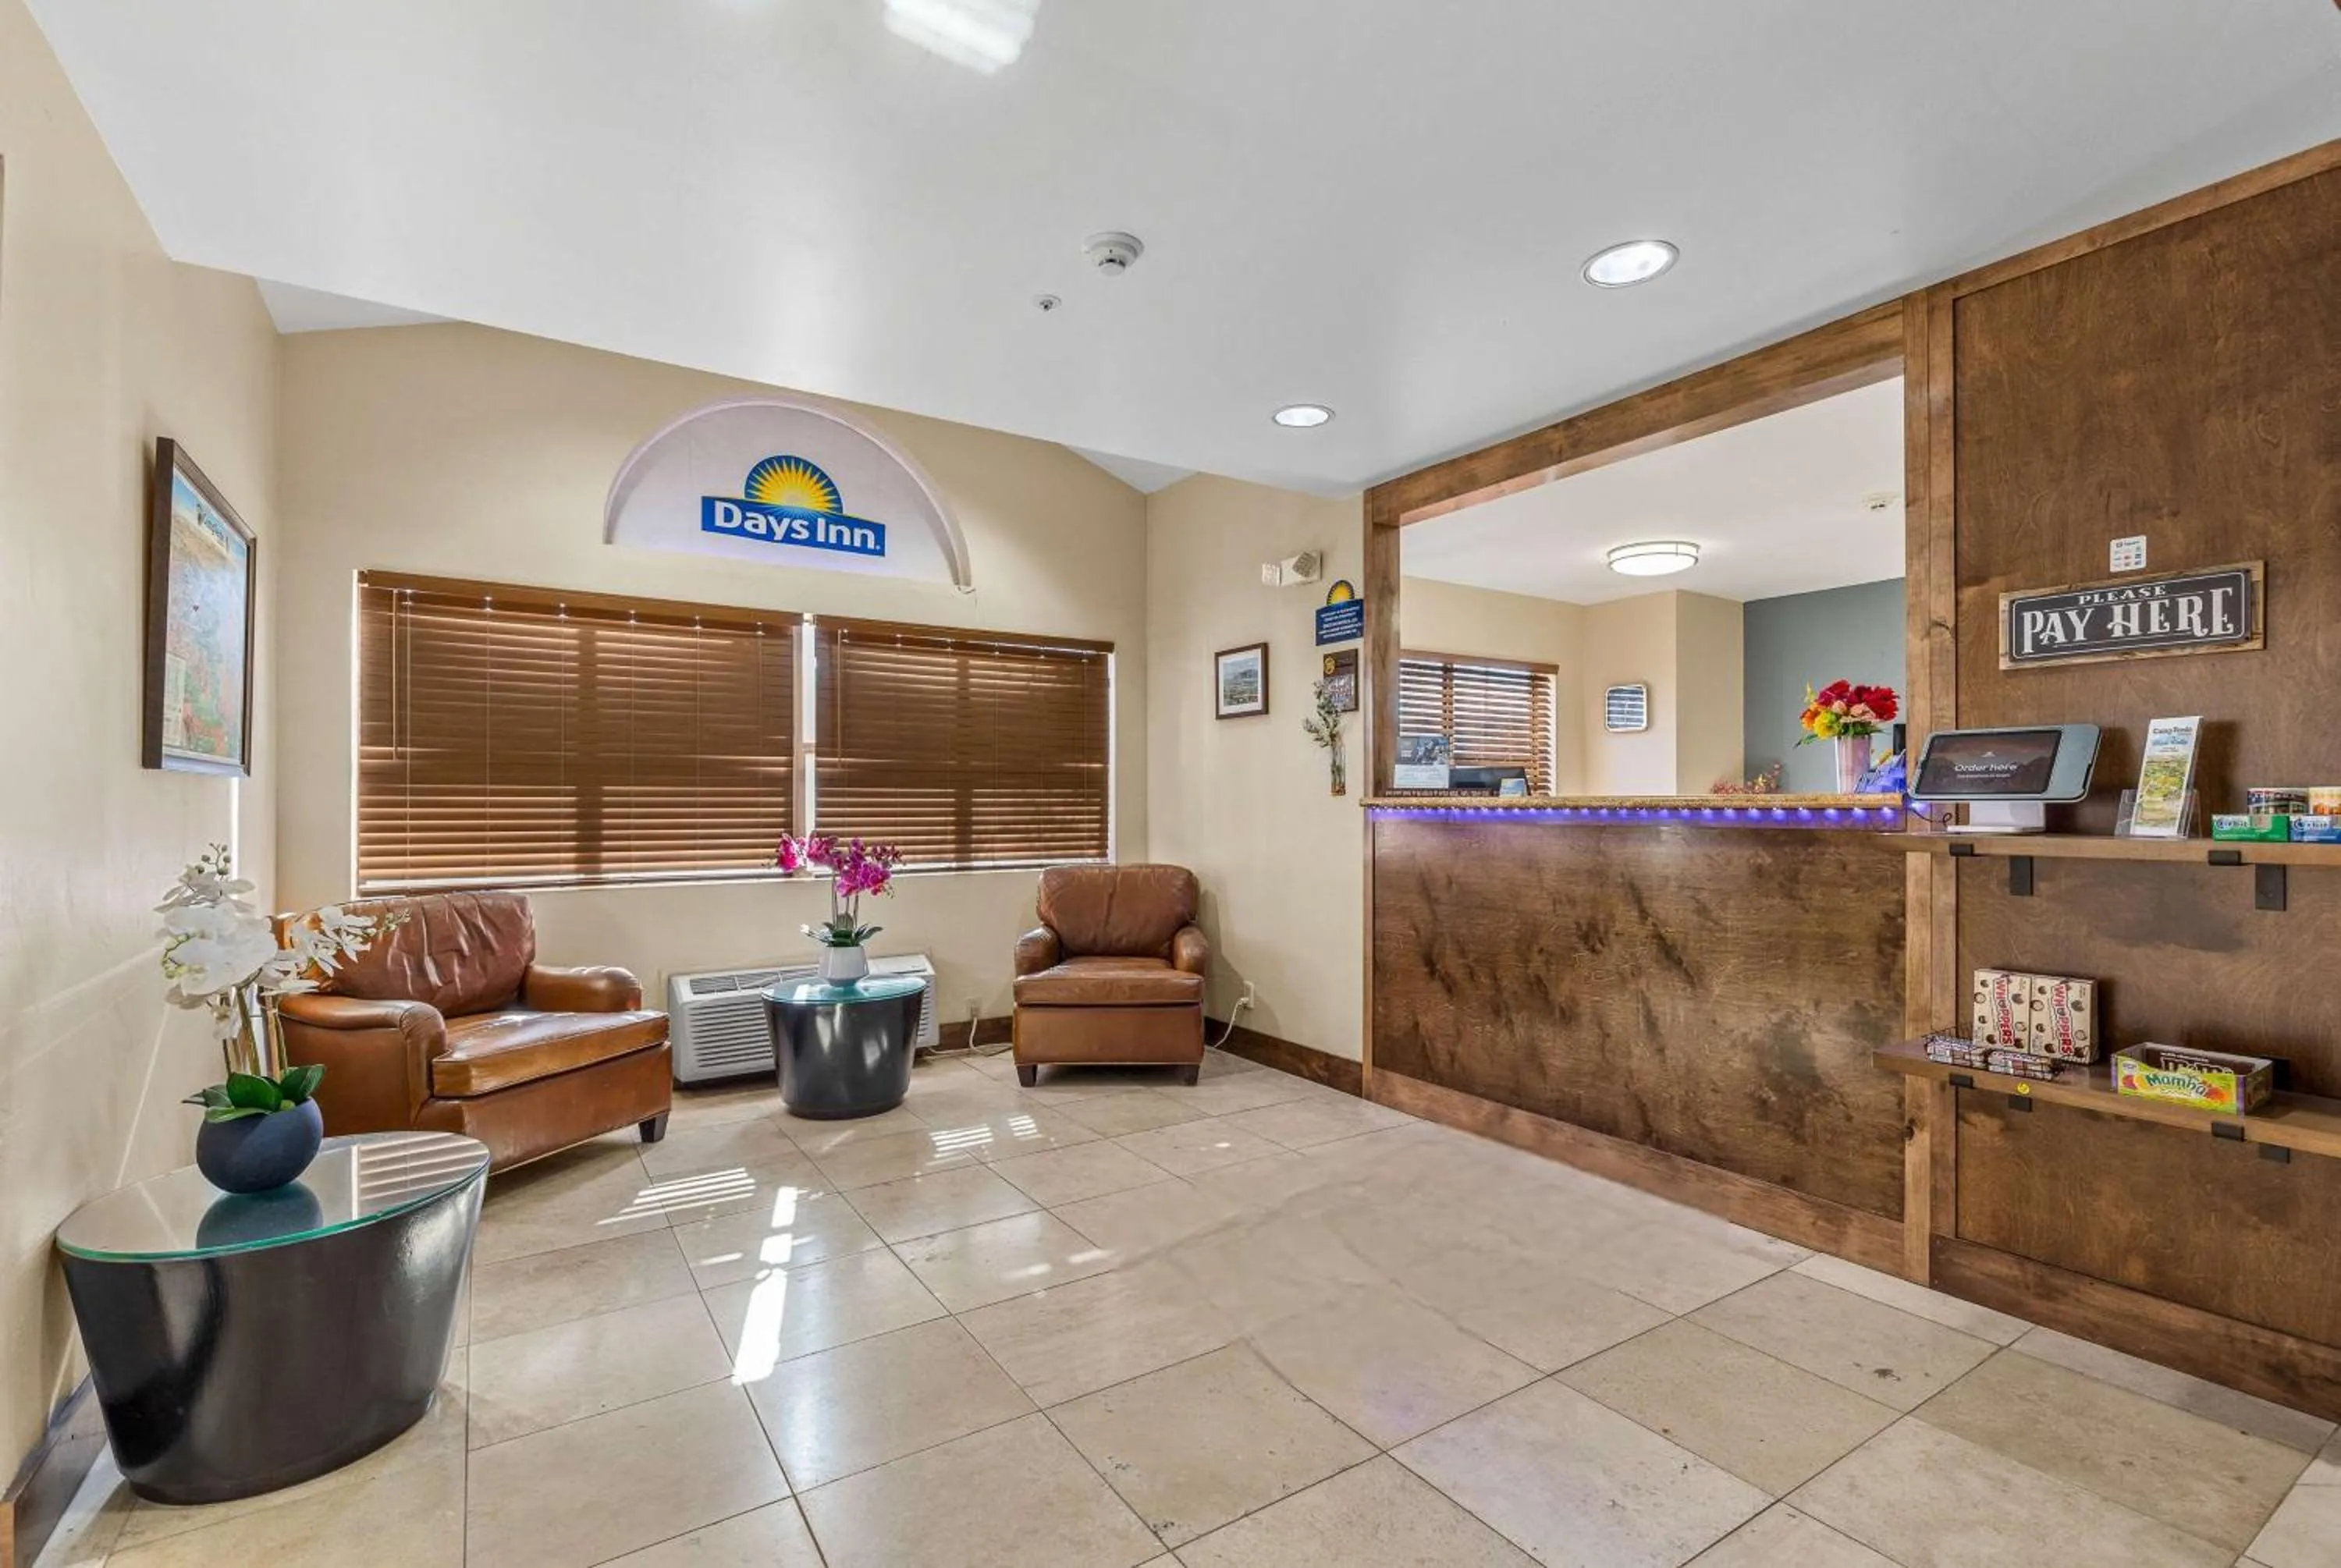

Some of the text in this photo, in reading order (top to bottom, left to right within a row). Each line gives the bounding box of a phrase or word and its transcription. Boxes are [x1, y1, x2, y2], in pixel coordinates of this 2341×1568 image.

[714, 500, 810, 541] Days
[2022, 587, 2234, 655] PAY HERE
[2079, 585, 2167, 605] PLEASE
[1995, 979, 2013, 1045] WHOPPERS
[2053, 985, 2073, 1054] WHOPPERS
[2146, 1073, 2206, 1094] Mamba
